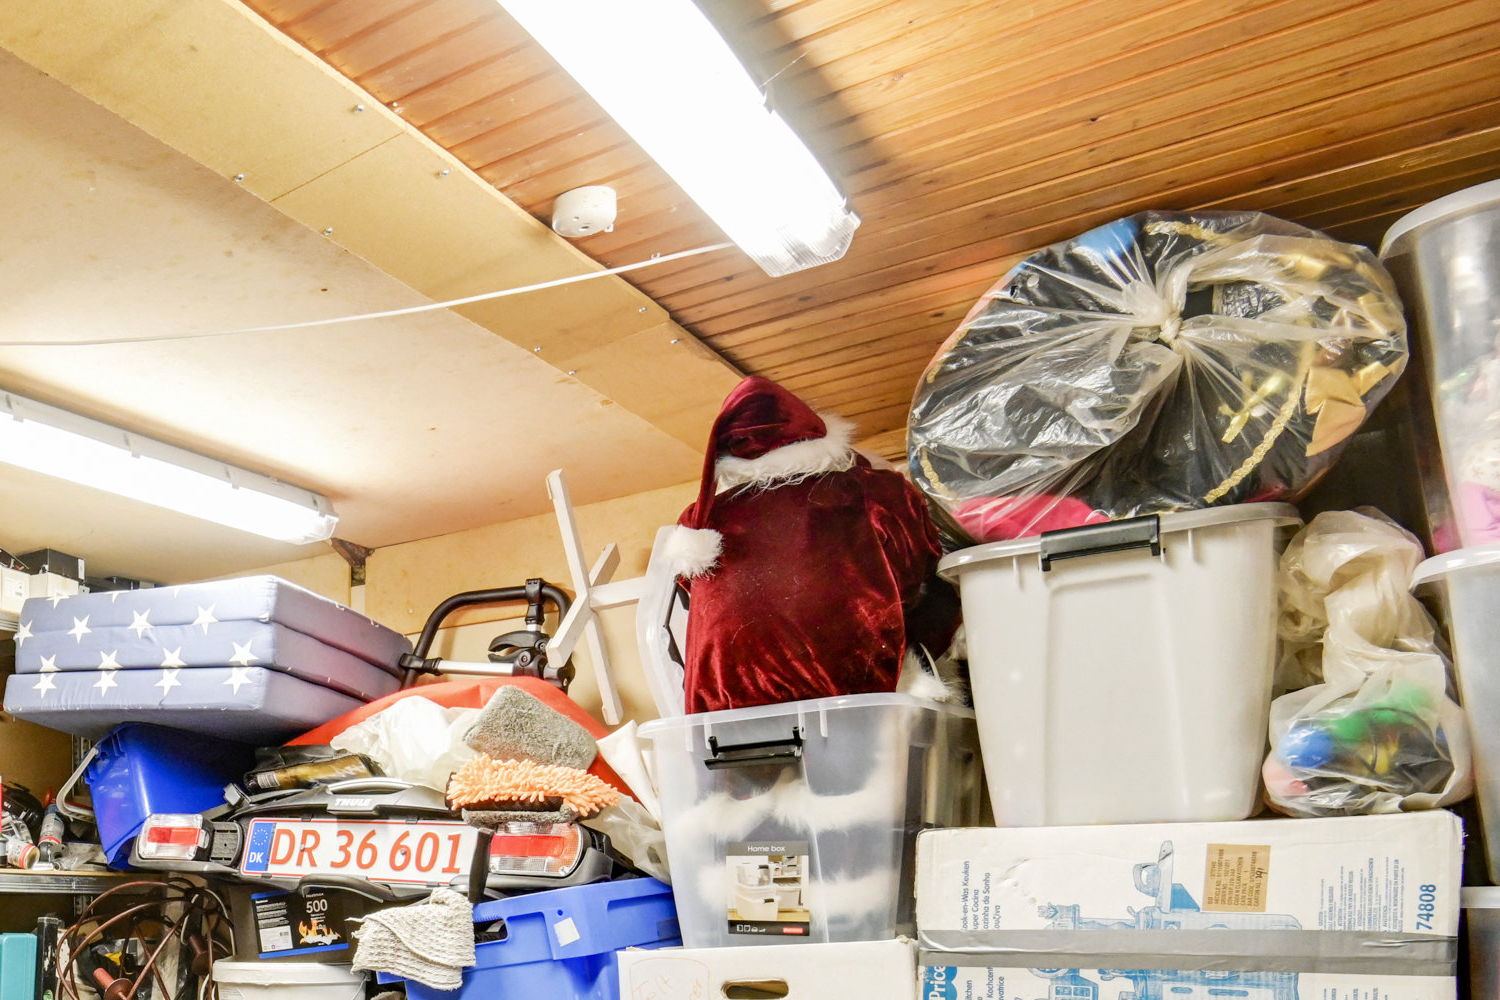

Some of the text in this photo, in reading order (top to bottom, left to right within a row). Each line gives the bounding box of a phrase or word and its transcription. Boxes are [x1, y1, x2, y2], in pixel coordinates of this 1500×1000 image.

[335, 798, 372, 806] THULE
[249, 852, 263, 863] DK
[270, 829, 462, 874] DR 36 601
[962, 861, 970, 887] Keuken
[306, 899, 328, 913] 500
[972, 889, 980, 912] Cocina
[982, 872, 991, 930] ozinha de Sonho
[1416, 884, 1437, 930] 74808
